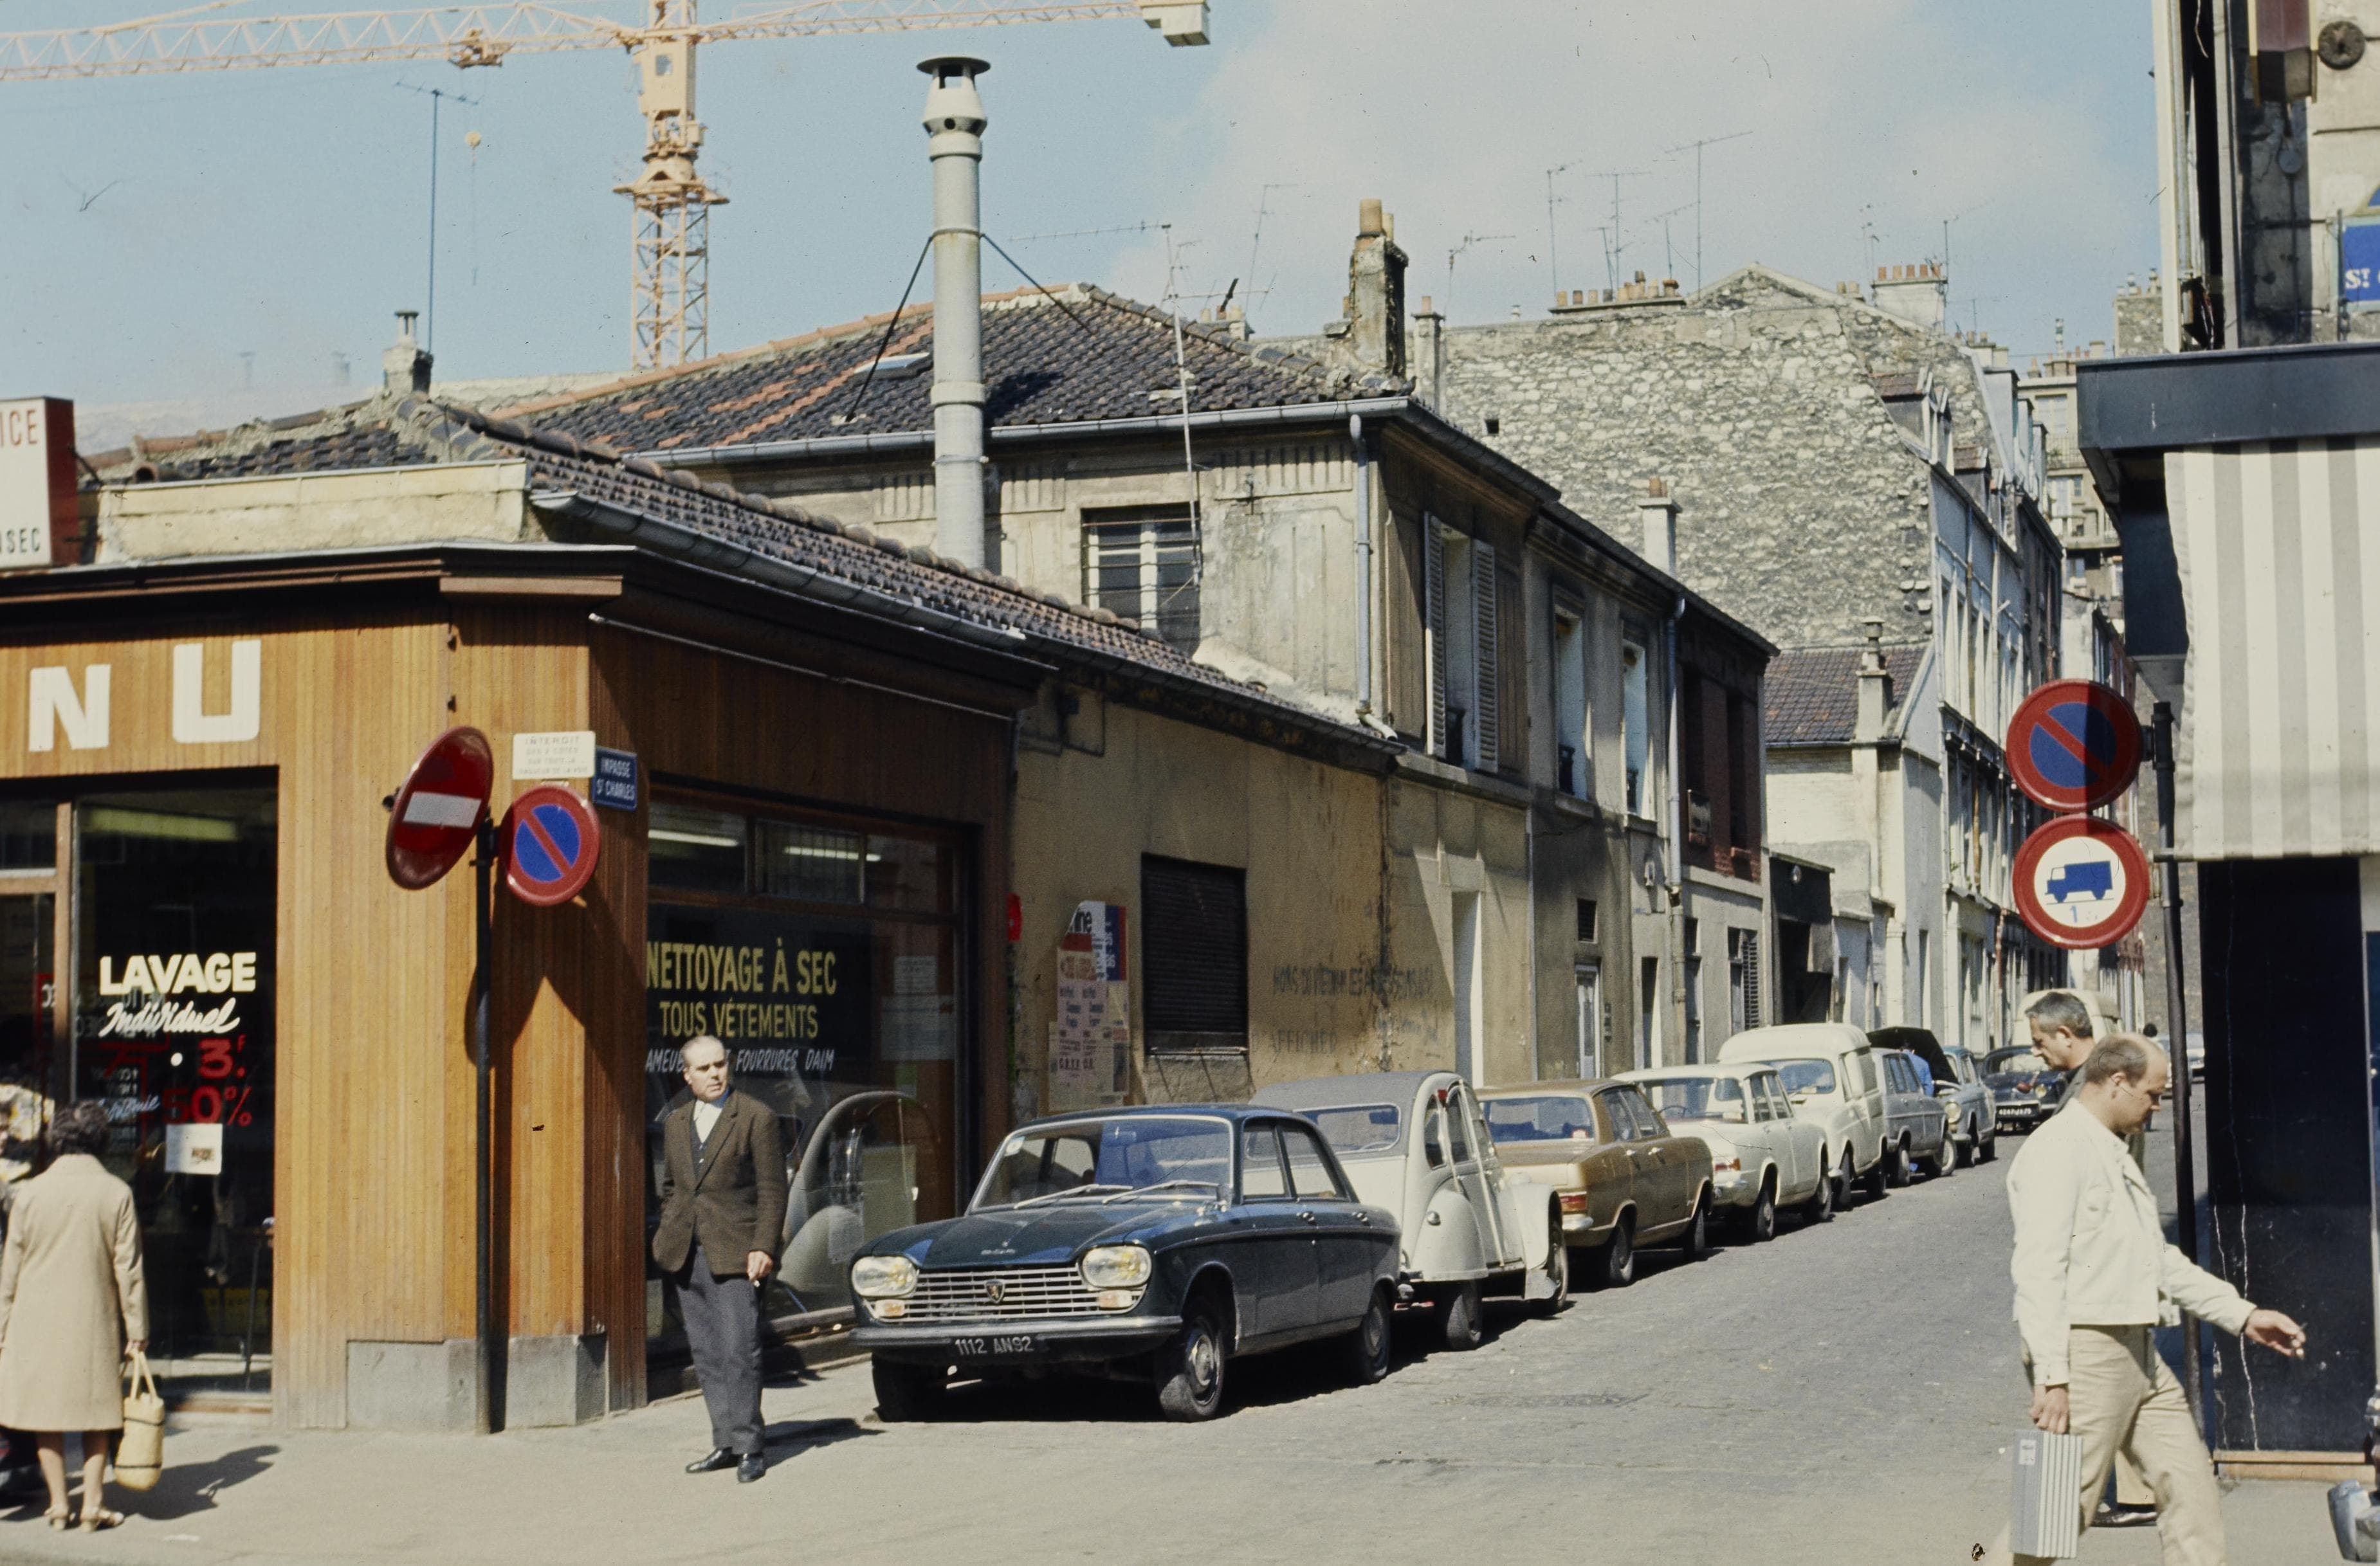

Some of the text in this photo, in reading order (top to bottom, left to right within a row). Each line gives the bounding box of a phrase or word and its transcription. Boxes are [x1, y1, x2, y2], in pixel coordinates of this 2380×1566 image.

[0, 528, 41, 554] SEC
[100, 952, 256, 996] LAVAGE
[646, 936, 836, 996] NETTOYAGE À SEC
[98, 997, 241, 1038] Individuel
[659, 1001, 707, 1037] TOUS
[735, 1049, 798, 1073] FOURRURES
[804, 1050, 836, 1071] DAIM
[955, 1338, 987, 1355] 1112
